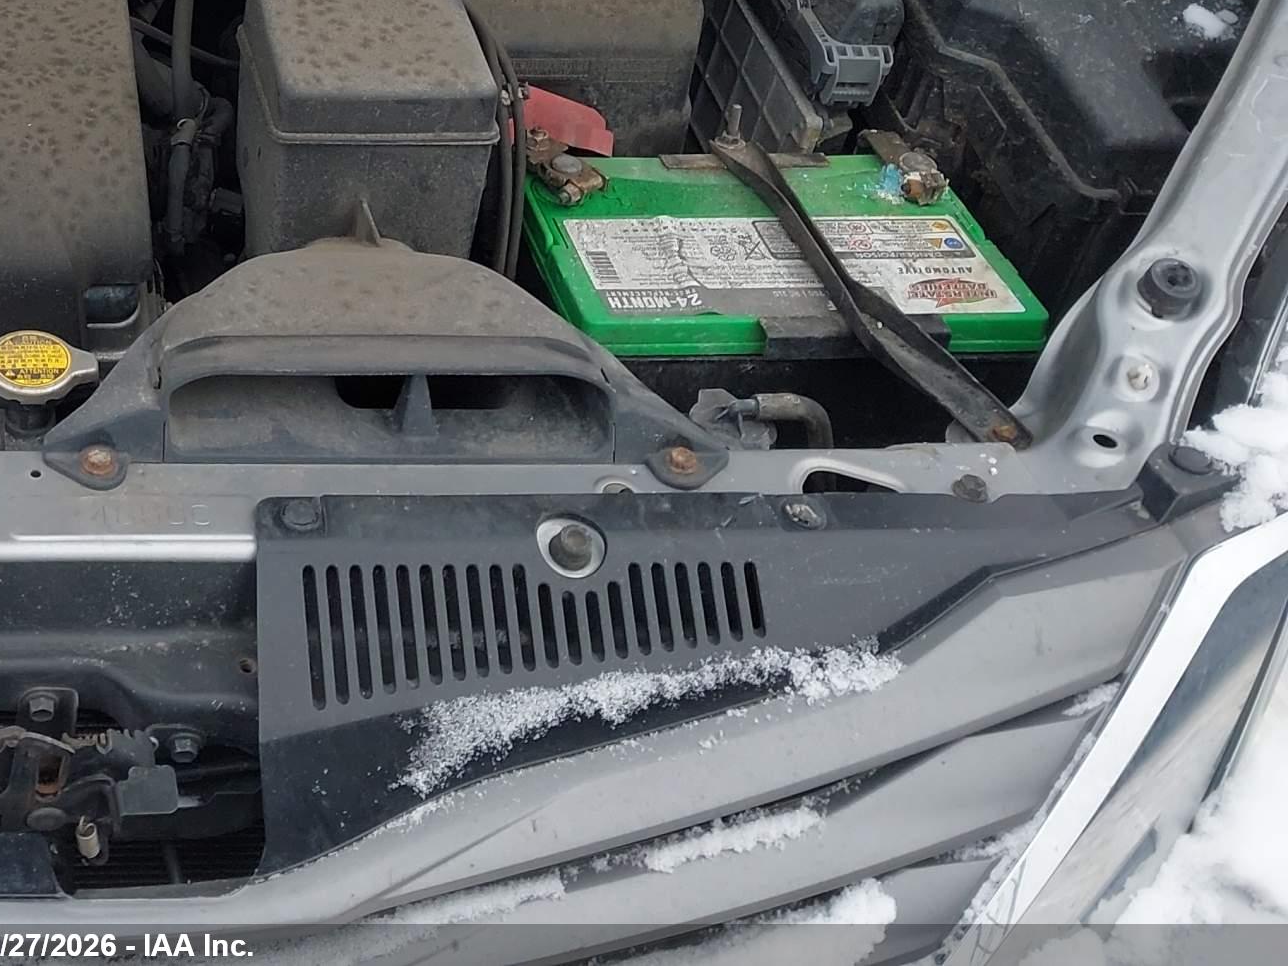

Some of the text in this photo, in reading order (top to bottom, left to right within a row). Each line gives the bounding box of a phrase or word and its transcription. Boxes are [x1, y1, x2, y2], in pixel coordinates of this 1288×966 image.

[897, 266, 973, 275] AUTOMOTIVE
[909, 282, 989, 291] BATTERIES
[906, 289, 998, 300] INTERSTATE
[607, 293, 703, 309] 24-MONTH
